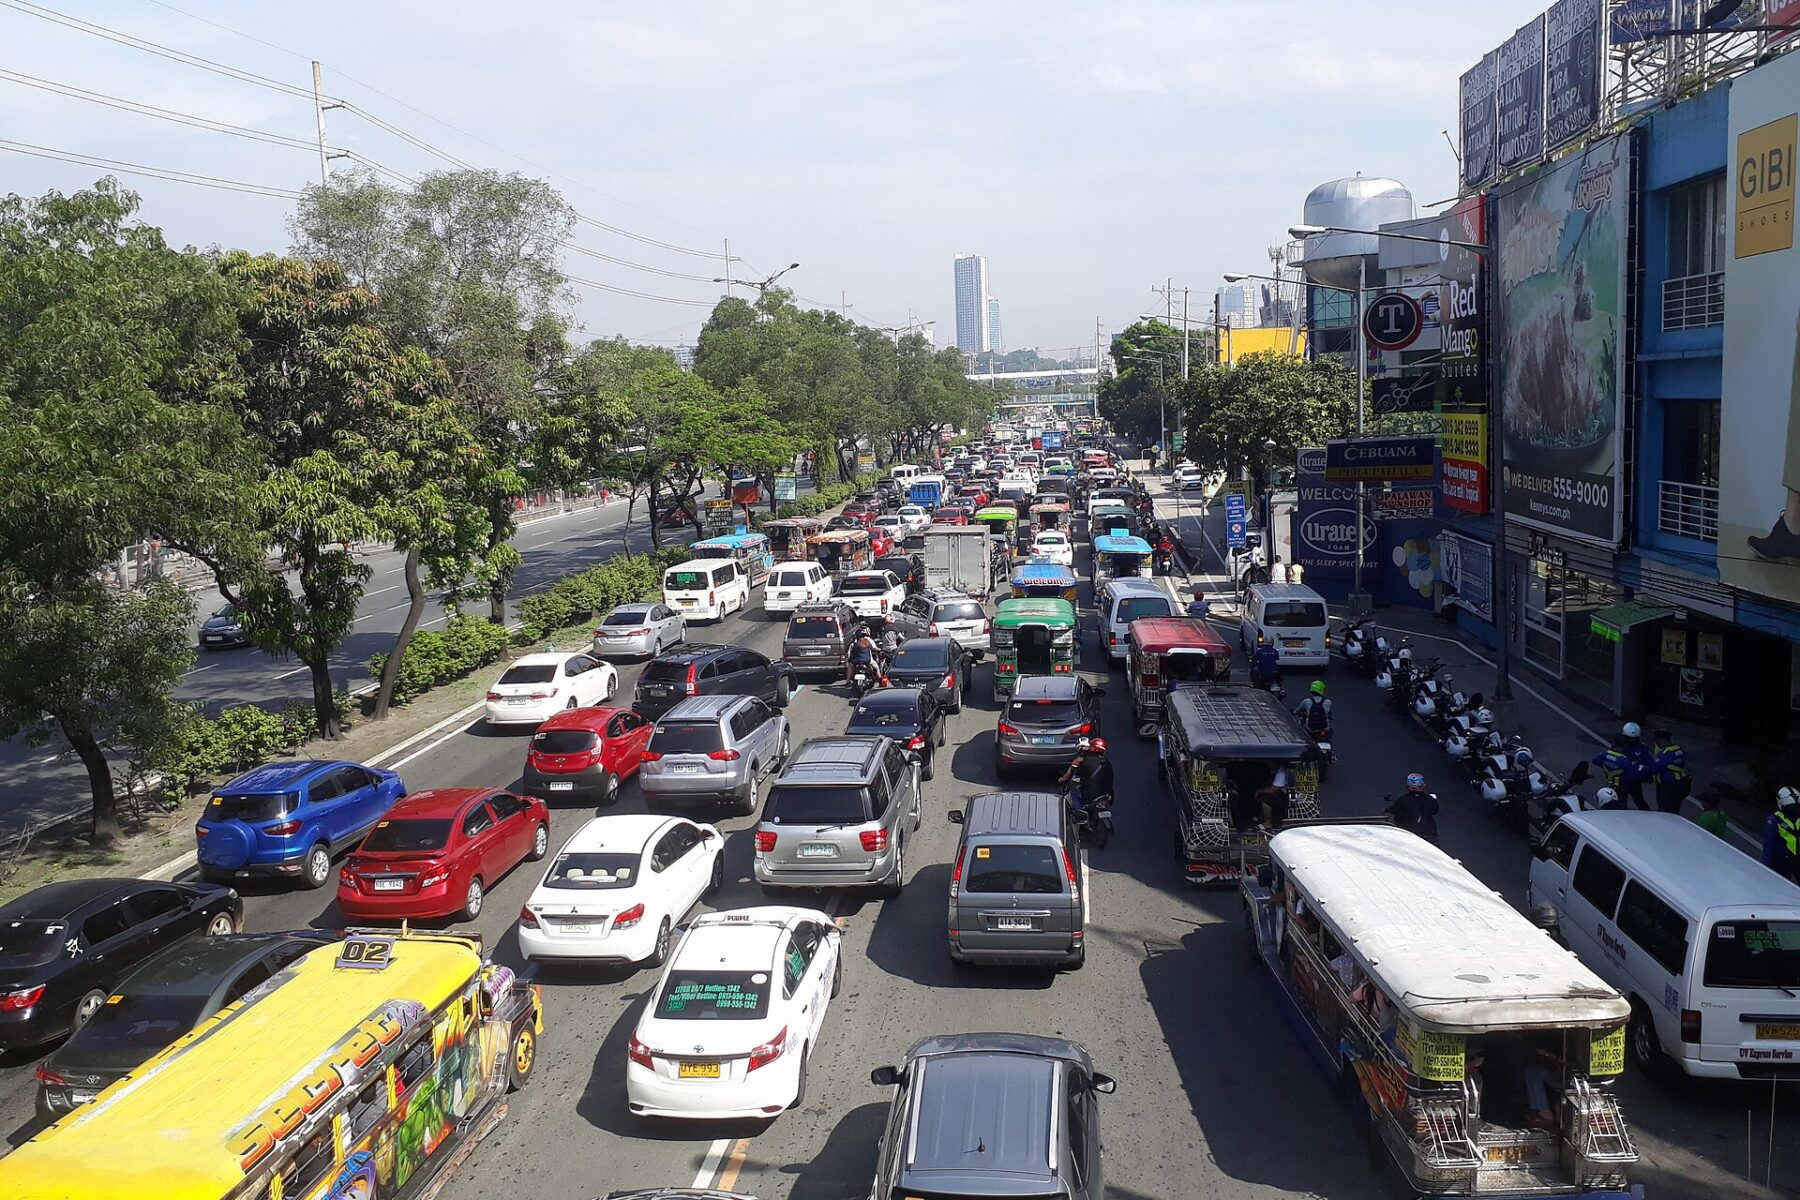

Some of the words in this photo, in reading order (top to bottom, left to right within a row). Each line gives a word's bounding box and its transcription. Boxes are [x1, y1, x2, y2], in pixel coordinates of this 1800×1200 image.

[1741, 143, 1792, 198] GIBI
[1740, 210, 1789, 231] SHOES
[1449, 273, 1478, 320] Red
[1378, 304, 1405, 334] T
[1441, 324, 1478, 357] Mango
[1441, 362, 1478, 378] Suites
[1454, 419, 1464, 435] 342
[1344, 446, 1417, 460] CEBUANA
[1340, 467, 1369, 477] PERA
[1374, 466, 1419, 477] PADALA
[1384, 491, 1431, 501] PALAWAN
[1510, 472, 1522, 488] WE
[1523, 474, 1552, 495] DELIVER
[1553, 476, 1609, 508] 555-9000
[1529, 498, 1571, 520] kennys.com.ph
[1317, 559, 1337, 567] SLEEP
[341, 942, 389, 964] 02
[668, 993, 696, 1001] Text/Viber
[696, 992, 717, 1000] Hotline:
[691, 984, 703, 993] 24/7
[704, 984, 726, 992] Hotline:
[727, 985, 741, 993] 1342
[1740, 1048, 1748, 1058] UV
[1749, 1048, 1771, 1060] Express
[1772, 1048, 1793, 1059] Service
[702, 1063, 719, 1073] 993
